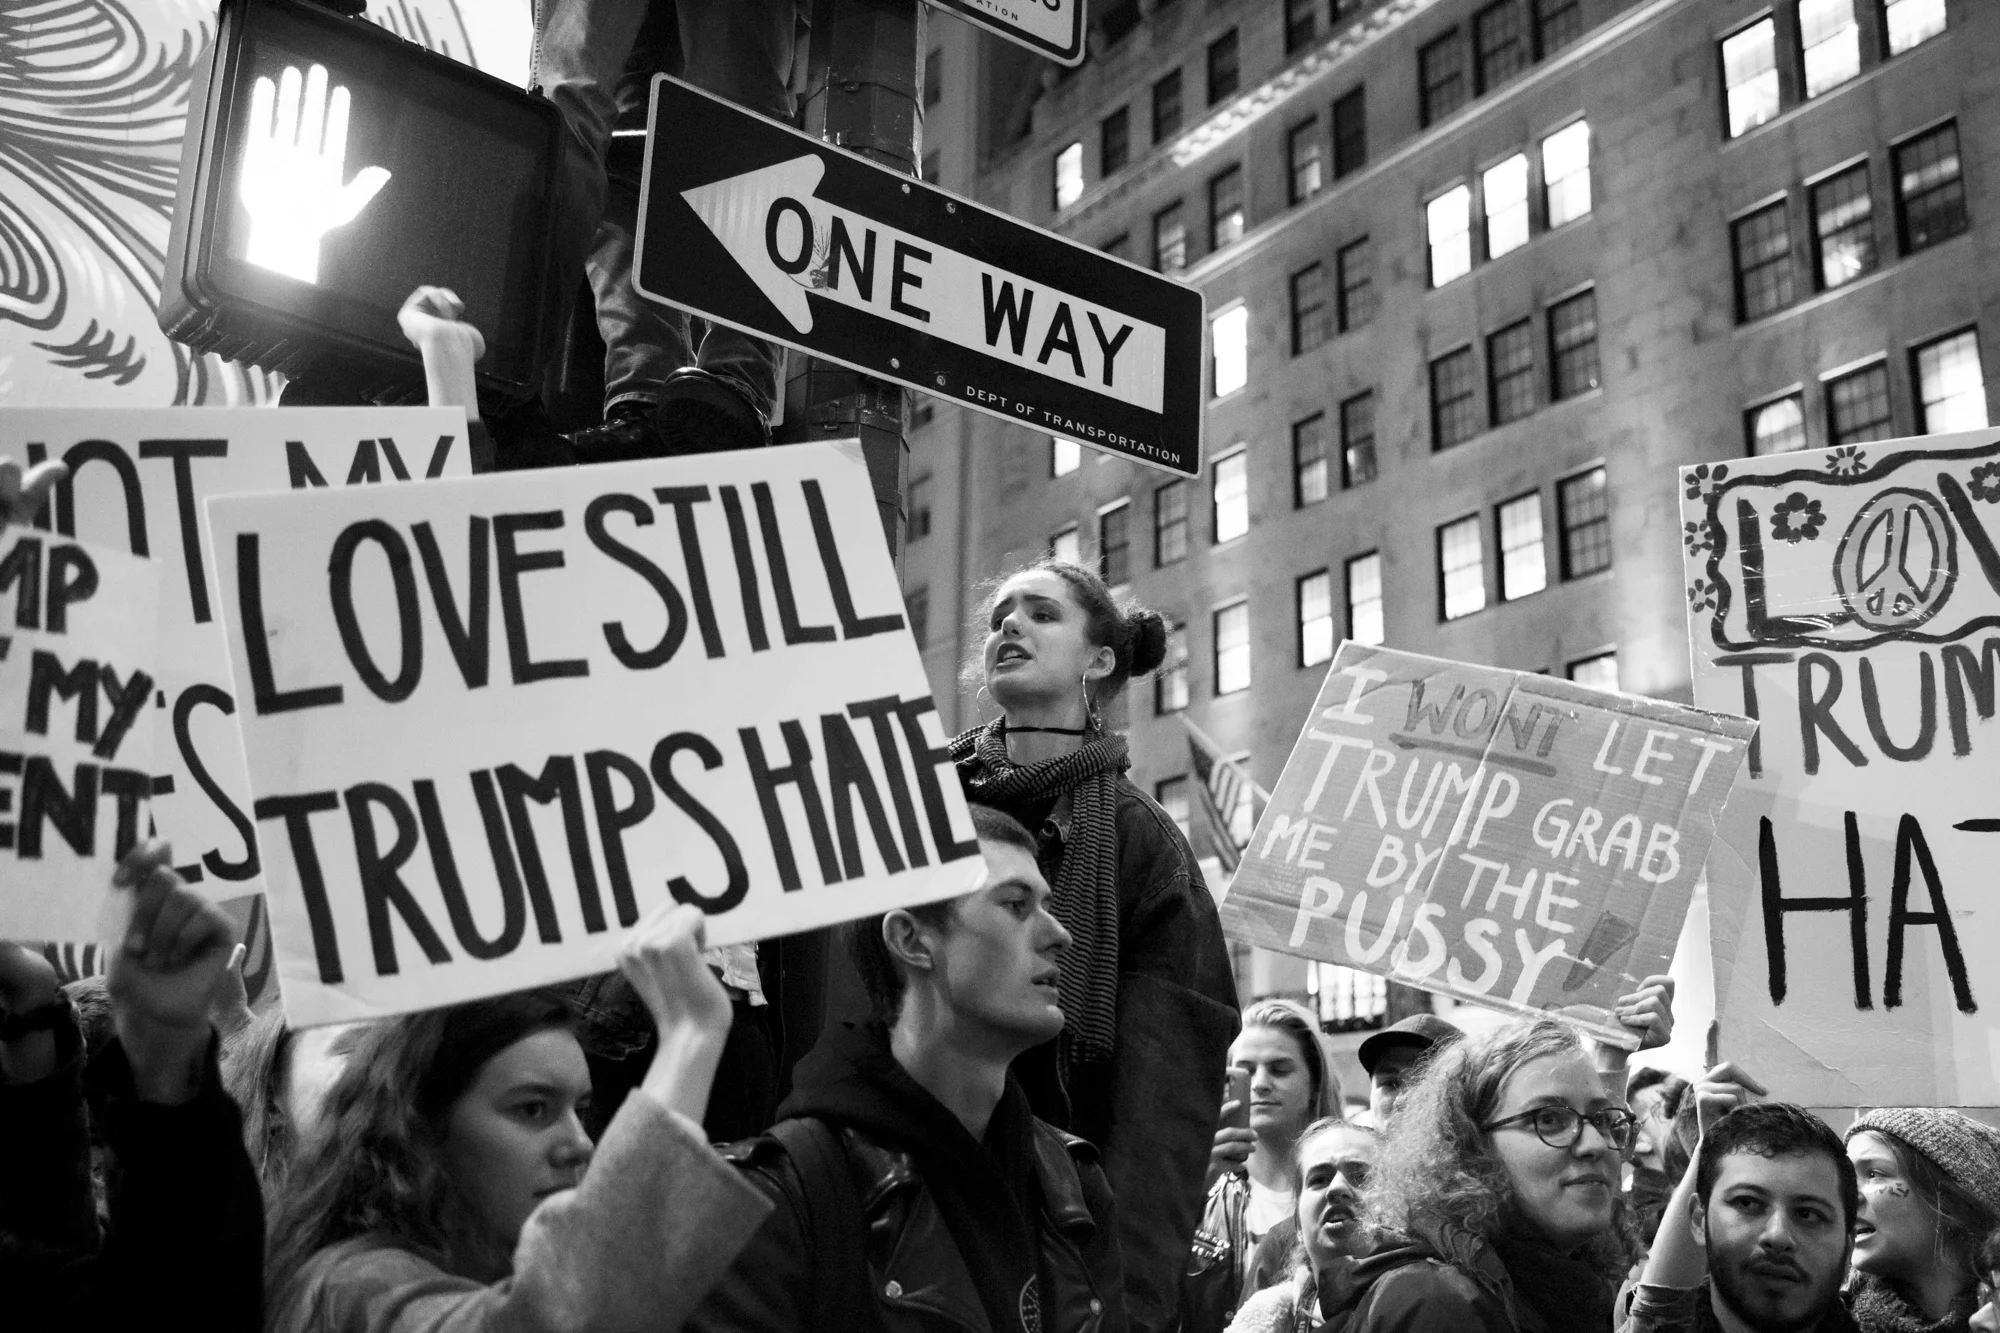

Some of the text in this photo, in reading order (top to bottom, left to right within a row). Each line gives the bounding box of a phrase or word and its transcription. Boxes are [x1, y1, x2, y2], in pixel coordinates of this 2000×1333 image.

[765, 197, 1134, 387] ONE WAY
[966, 385, 1181, 464] DEPT OF TRANSPORTATION
[236, 478, 905, 716] LOVE STILL
[25, 649, 154, 761] MY
[1322, 667, 1387, 726] I
[1592, 720, 1733, 795] LET
[255, 731, 749, 985] TRUMPS
[738, 694, 982, 894] HATE
[1260, 814, 1581, 934] ME BY THE
[1303, 728, 1681, 884] TRUMP GRAB
[1758, 810, 2000, 1014] HA
